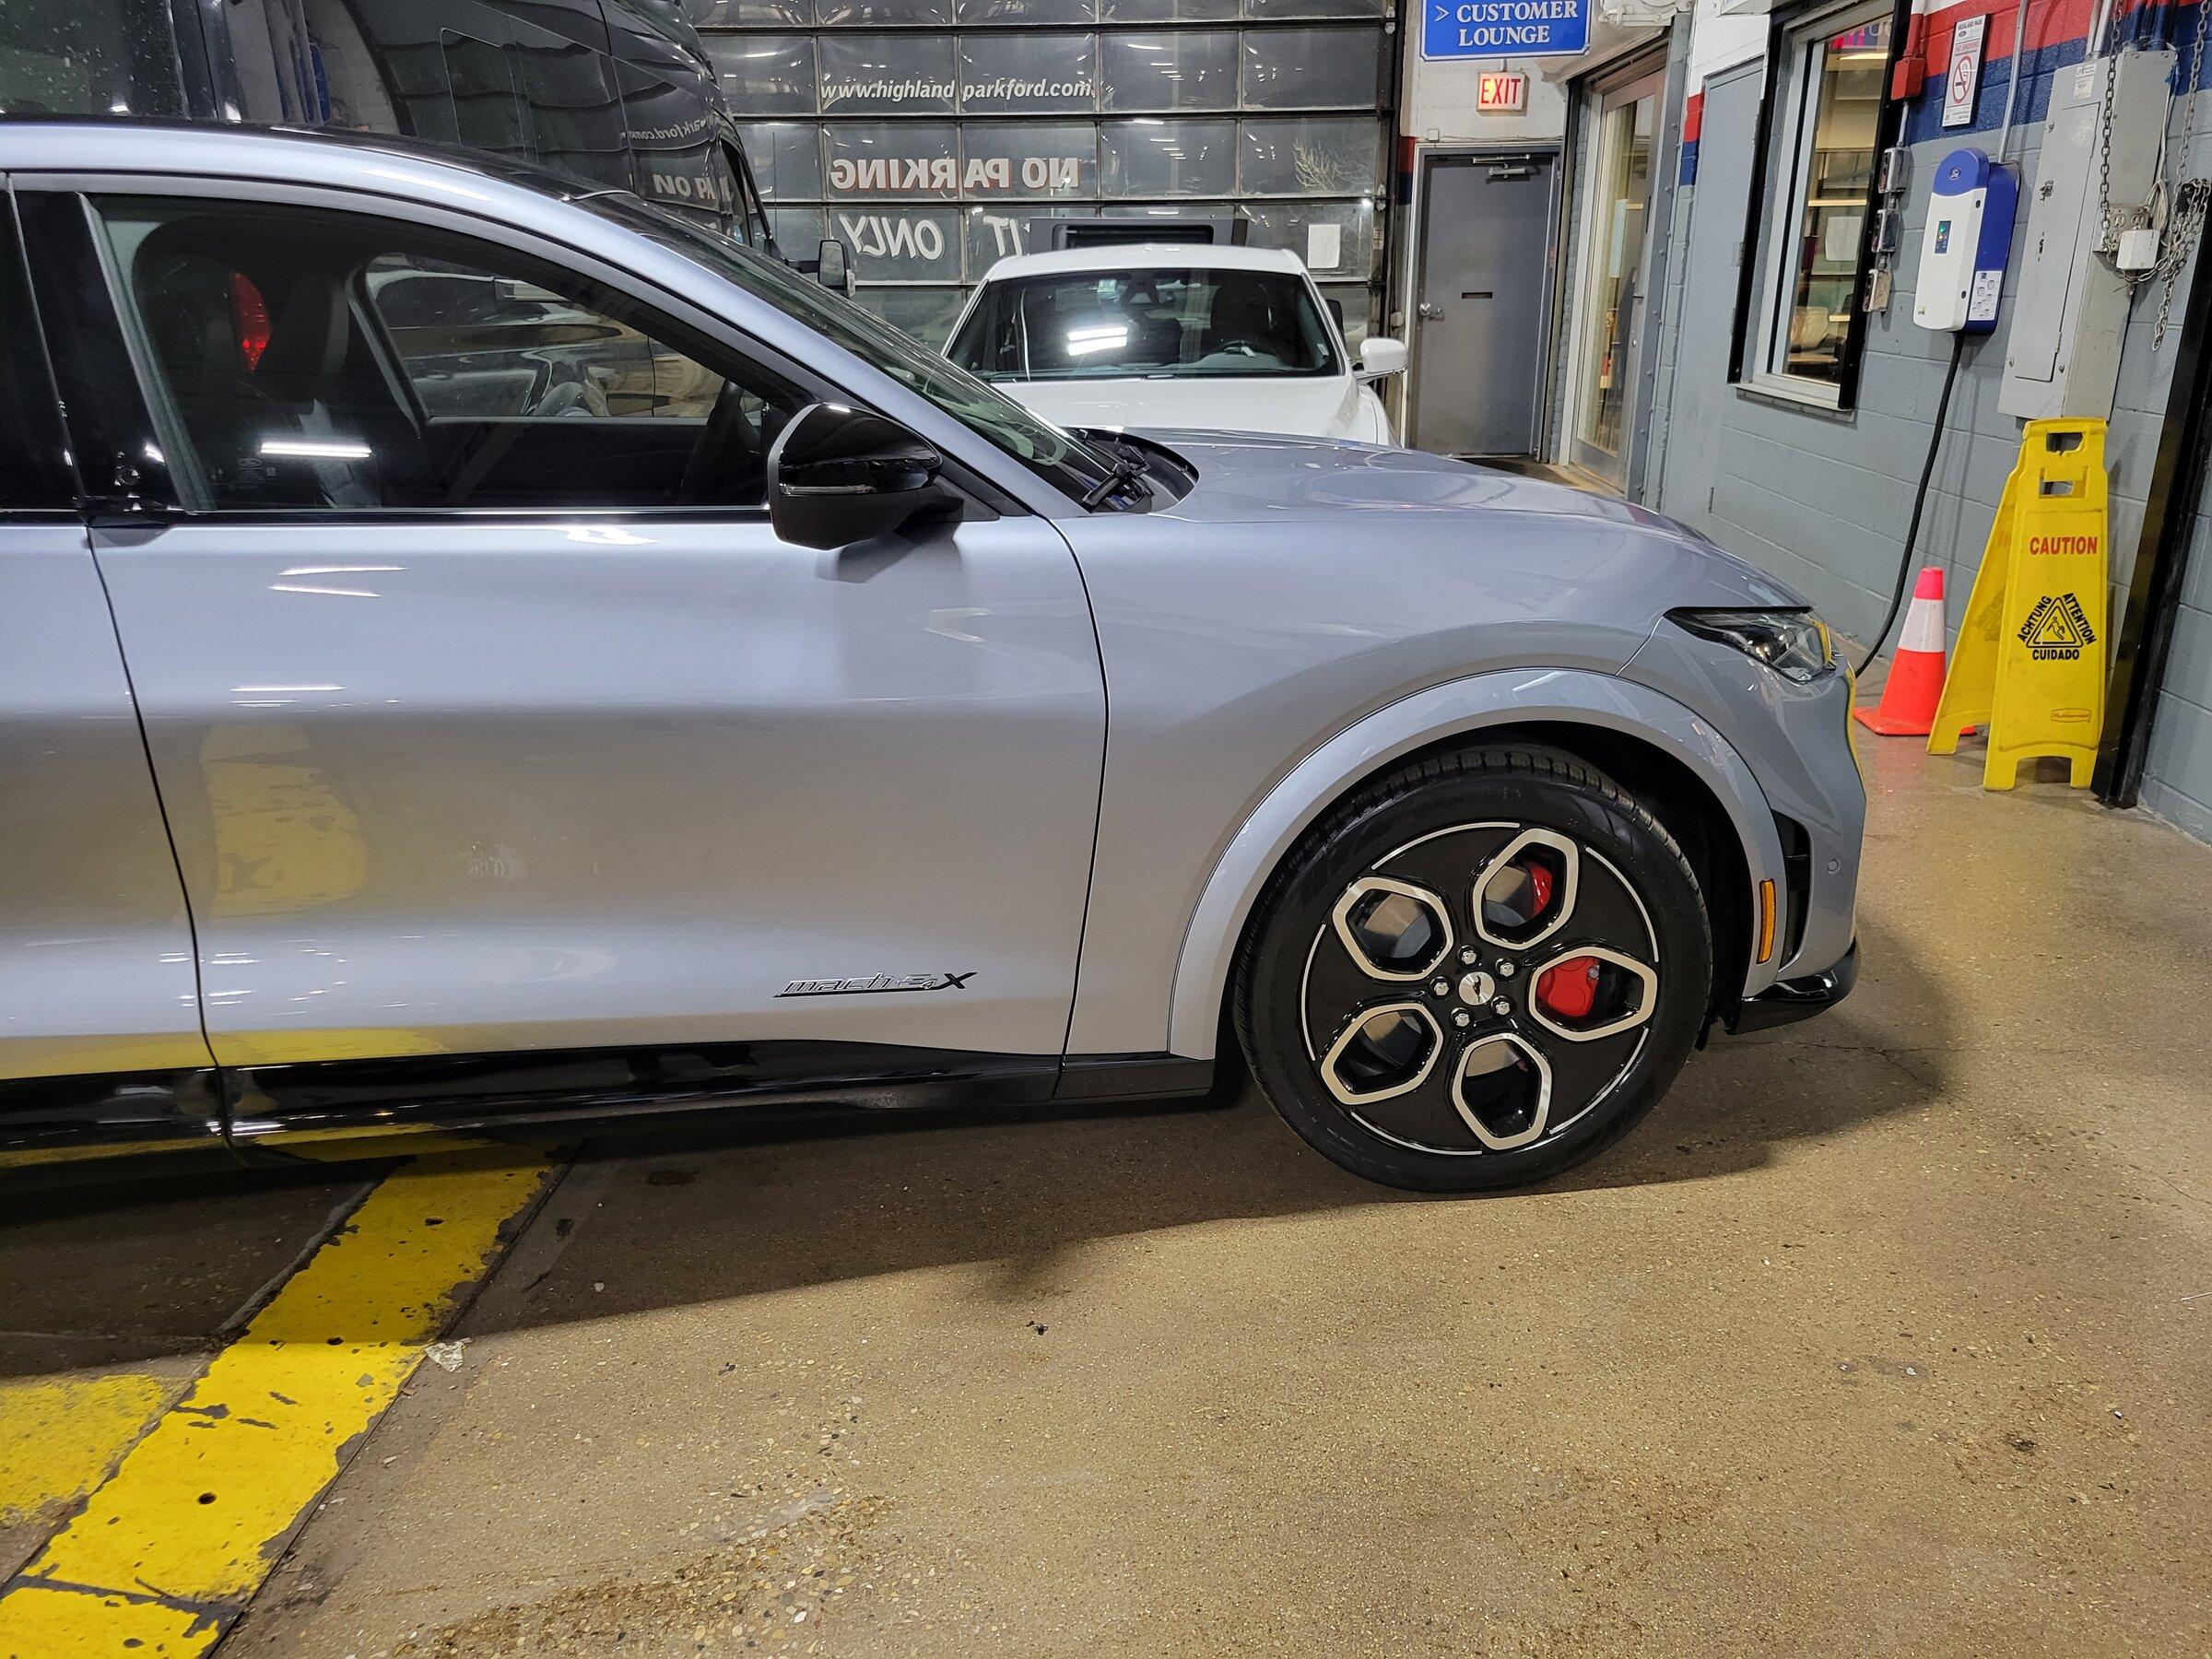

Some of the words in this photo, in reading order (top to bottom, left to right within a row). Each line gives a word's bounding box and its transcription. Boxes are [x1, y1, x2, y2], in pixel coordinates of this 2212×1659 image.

[1456, 1, 1578, 23] CUSTOMER
[1458, 25, 1550, 46] LOUNGE
[1480, 78, 1521, 104] EXIT
[2030, 536, 2098, 555] CAUTION
[2017, 595, 2053, 642] ACHTUNG
[2062, 592, 2097, 645] ATTENTION
[2032, 649, 2080, 661] CUIDADO
